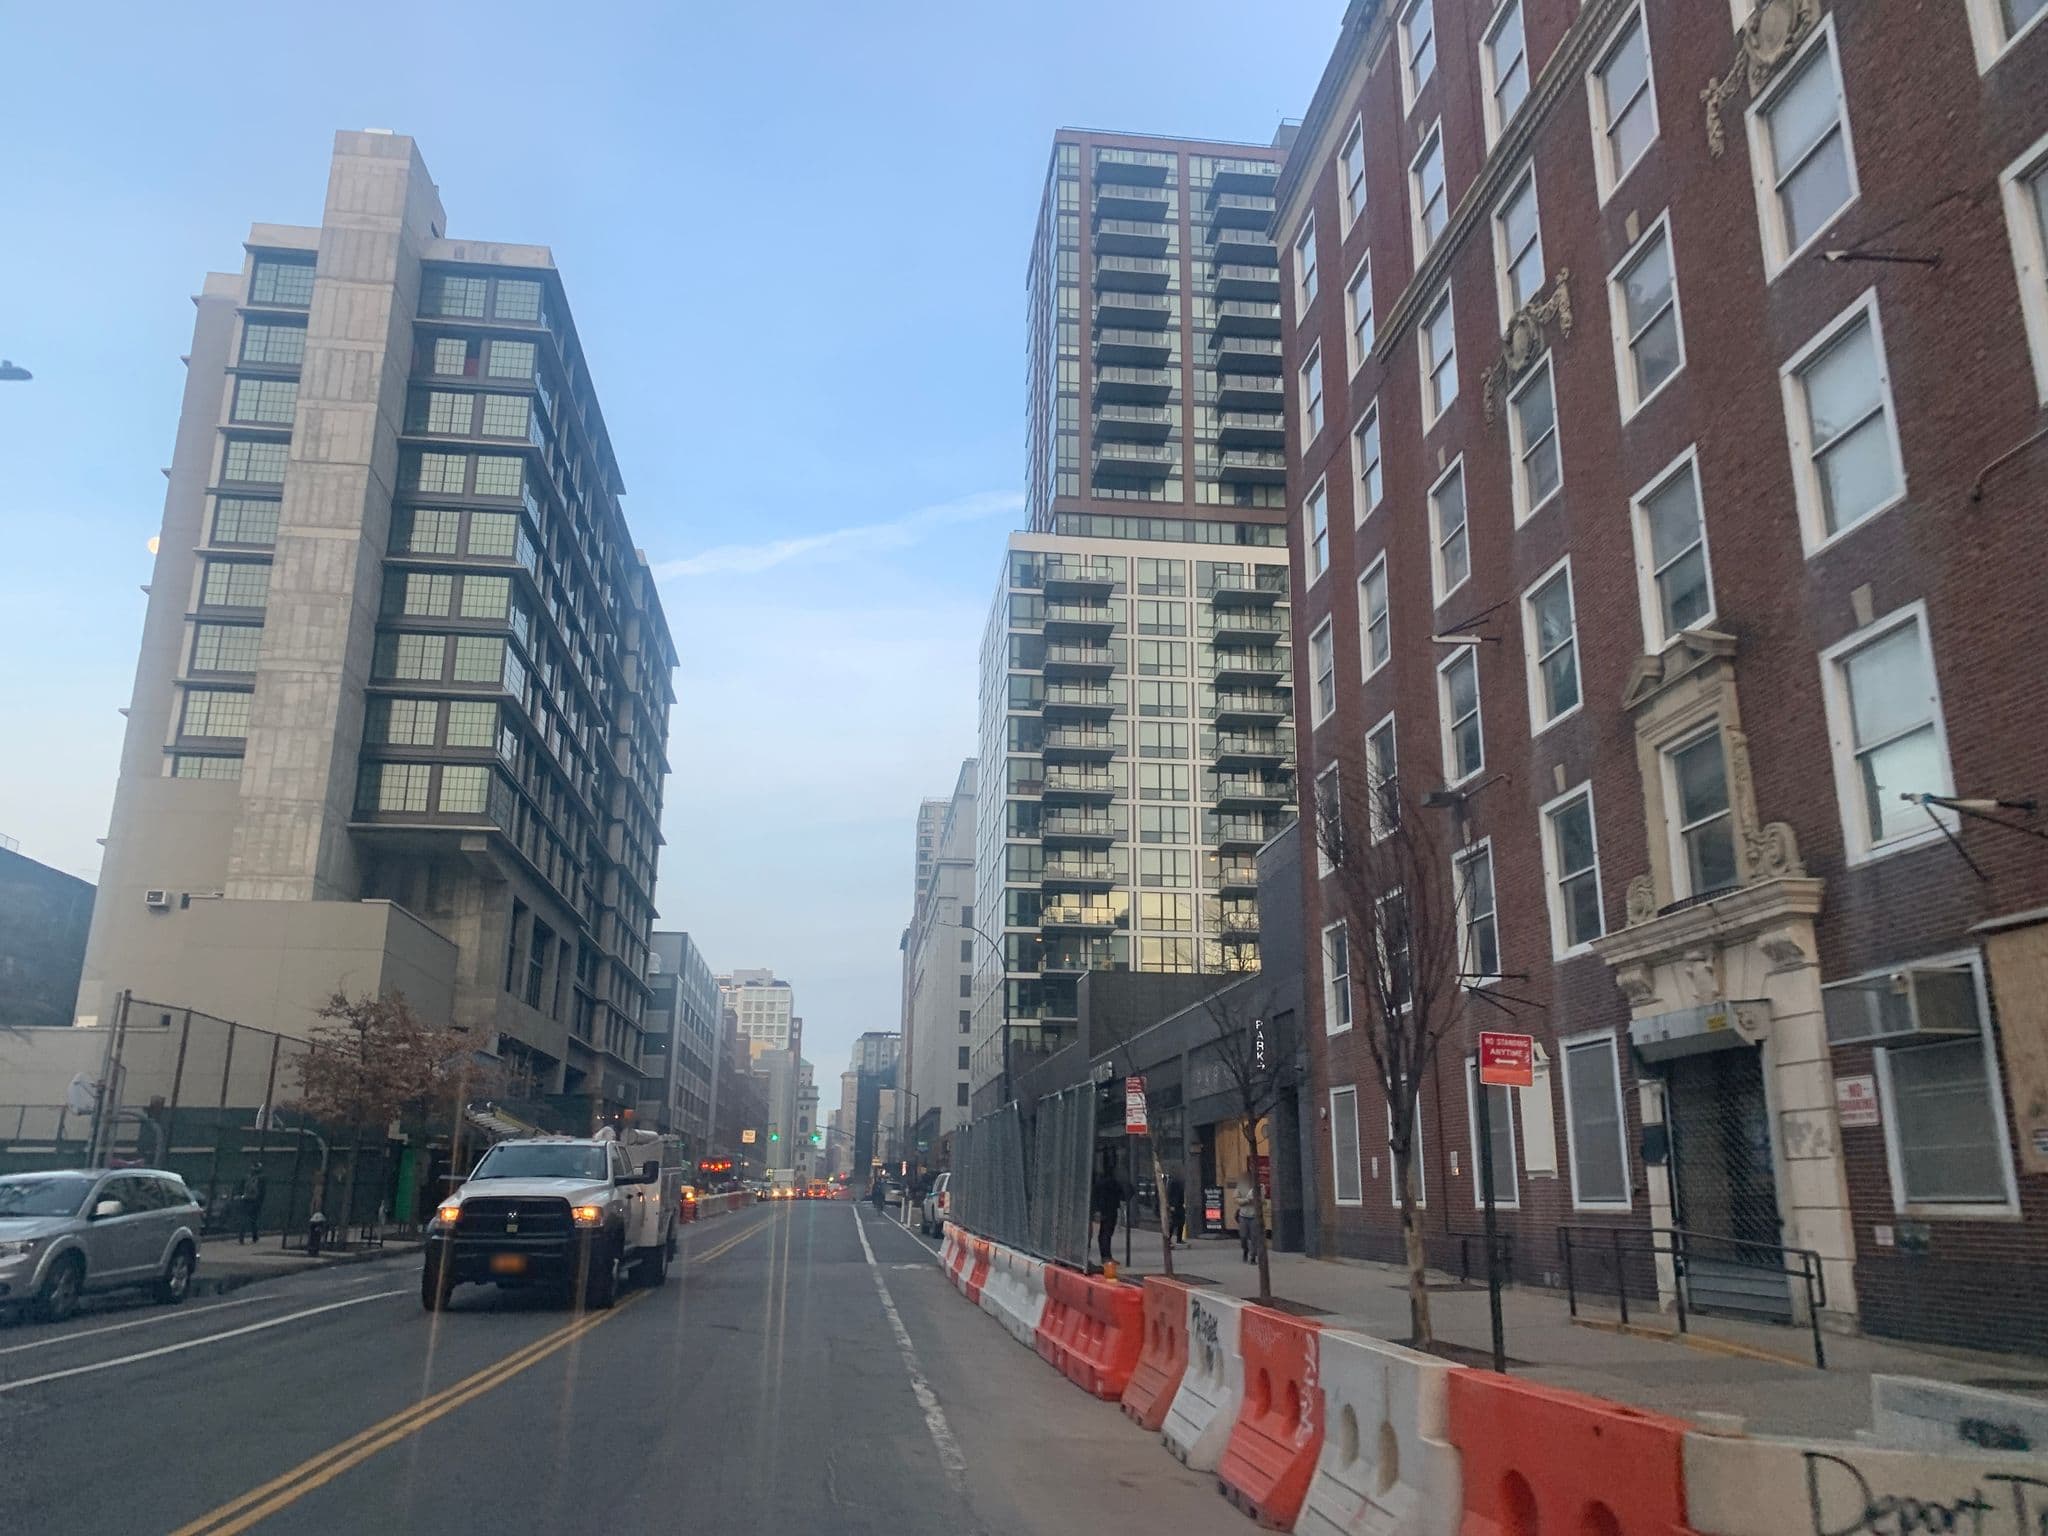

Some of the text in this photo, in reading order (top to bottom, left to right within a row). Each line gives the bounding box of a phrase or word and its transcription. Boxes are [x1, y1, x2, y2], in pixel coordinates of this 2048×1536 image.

[1255, 1020, 1265, 1061] PARK
[1496, 1038, 1529, 1047] STANDING
[1490, 1048, 1523, 1057] ANYTIME
